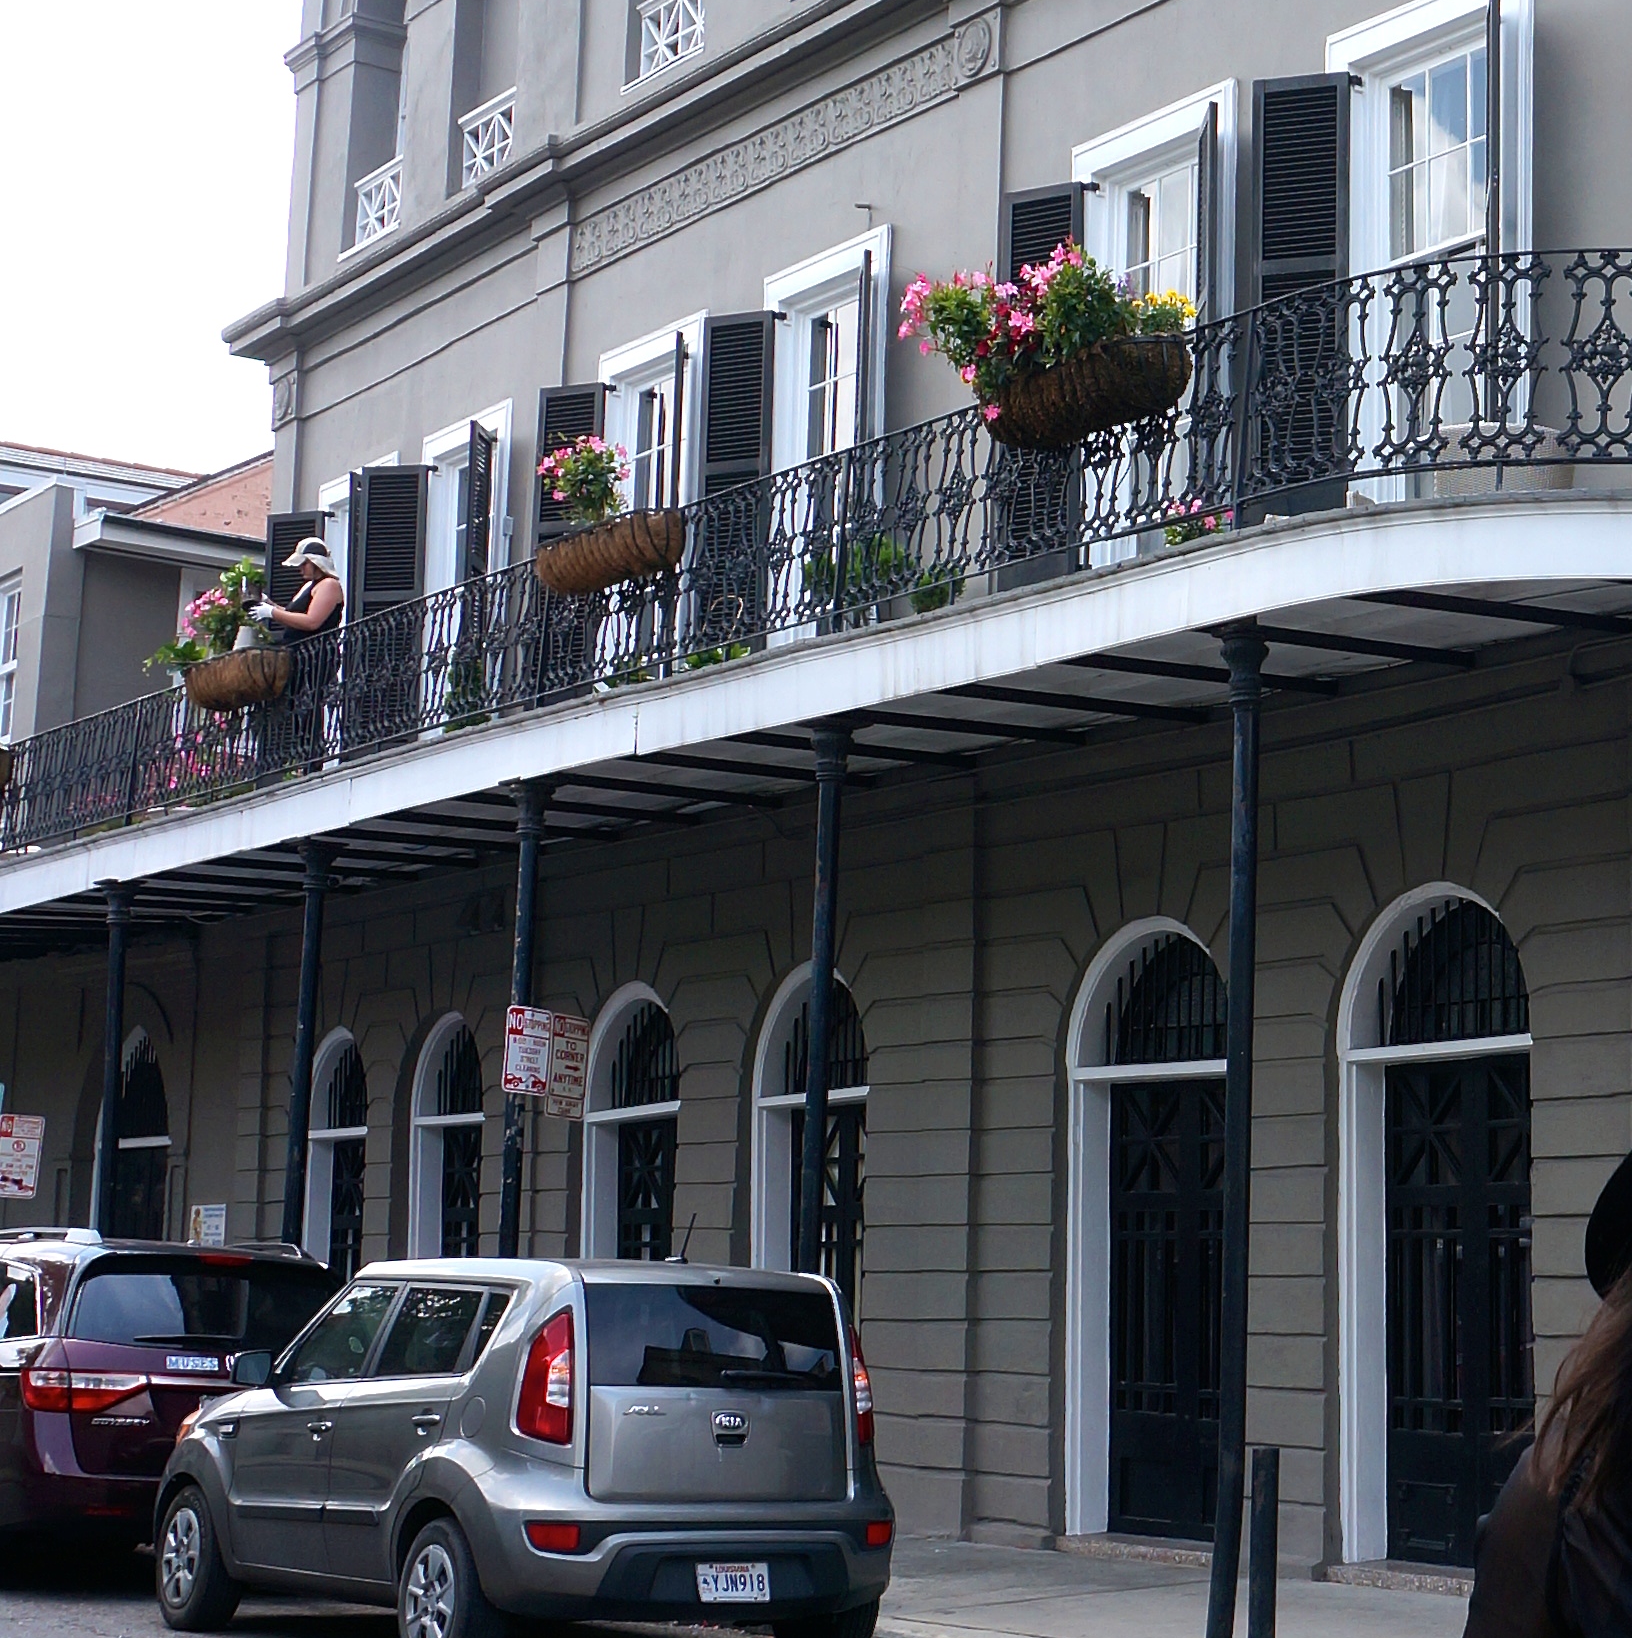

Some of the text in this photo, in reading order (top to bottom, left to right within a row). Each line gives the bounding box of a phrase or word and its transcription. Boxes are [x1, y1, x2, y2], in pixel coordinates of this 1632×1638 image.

[509, 1012, 524, 1030] NO
[555, 1017, 565, 1034] NO
[565, 1041, 577, 1051] TO
[555, 1048, 585, 1063] CORNER
[553, 1071, 584, 1087] ANYTIME
[167, 1356, 219, 1369] MUSES
[722, 1416, 743, 1427] KIA
